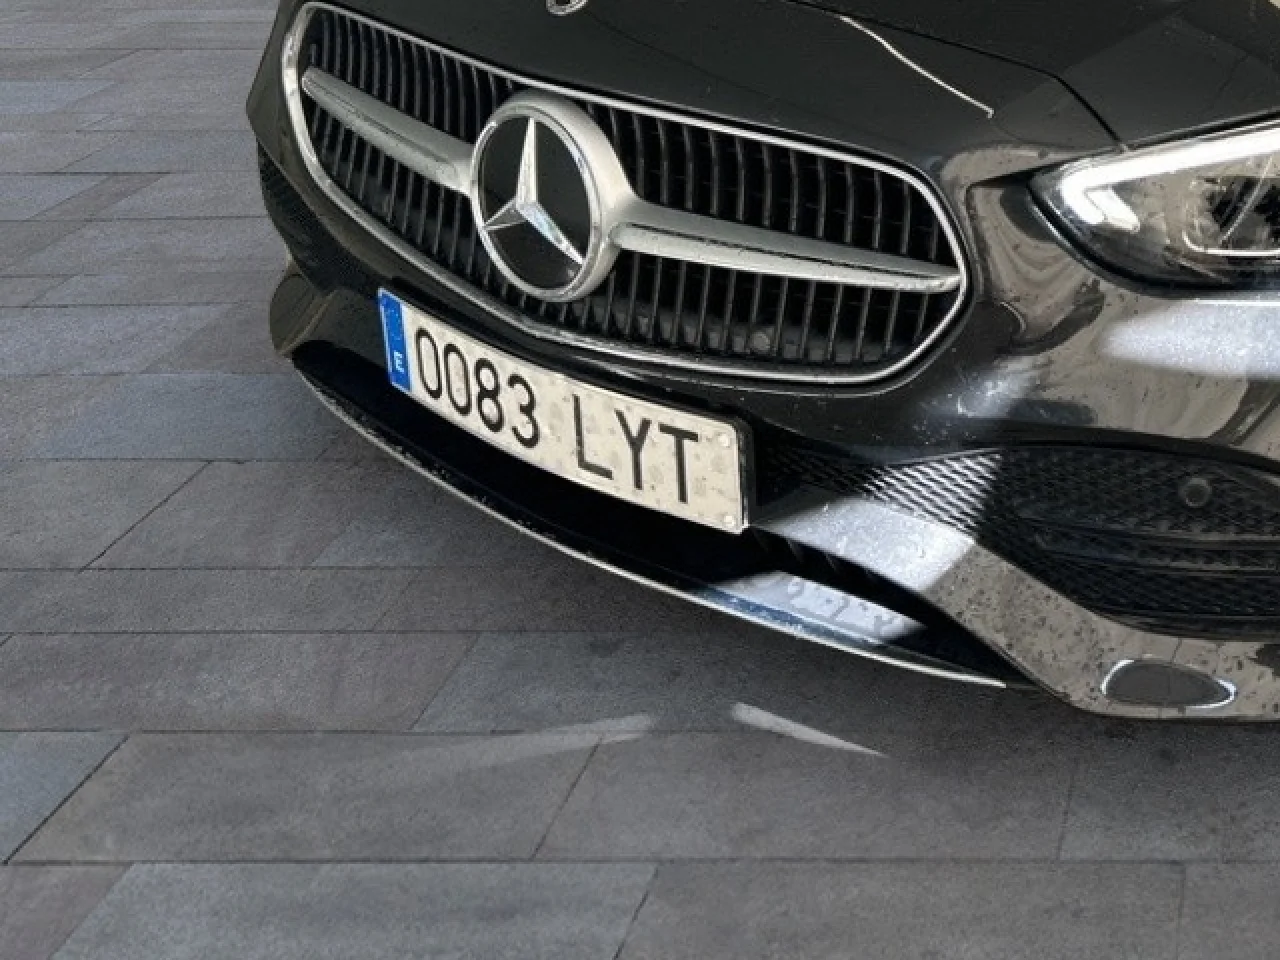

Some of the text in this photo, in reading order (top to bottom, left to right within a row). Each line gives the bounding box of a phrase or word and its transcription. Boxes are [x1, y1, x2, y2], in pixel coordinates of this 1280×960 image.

[393, 350, 404, 372] E
[415, 327, 699, 504] 0083 LYT
